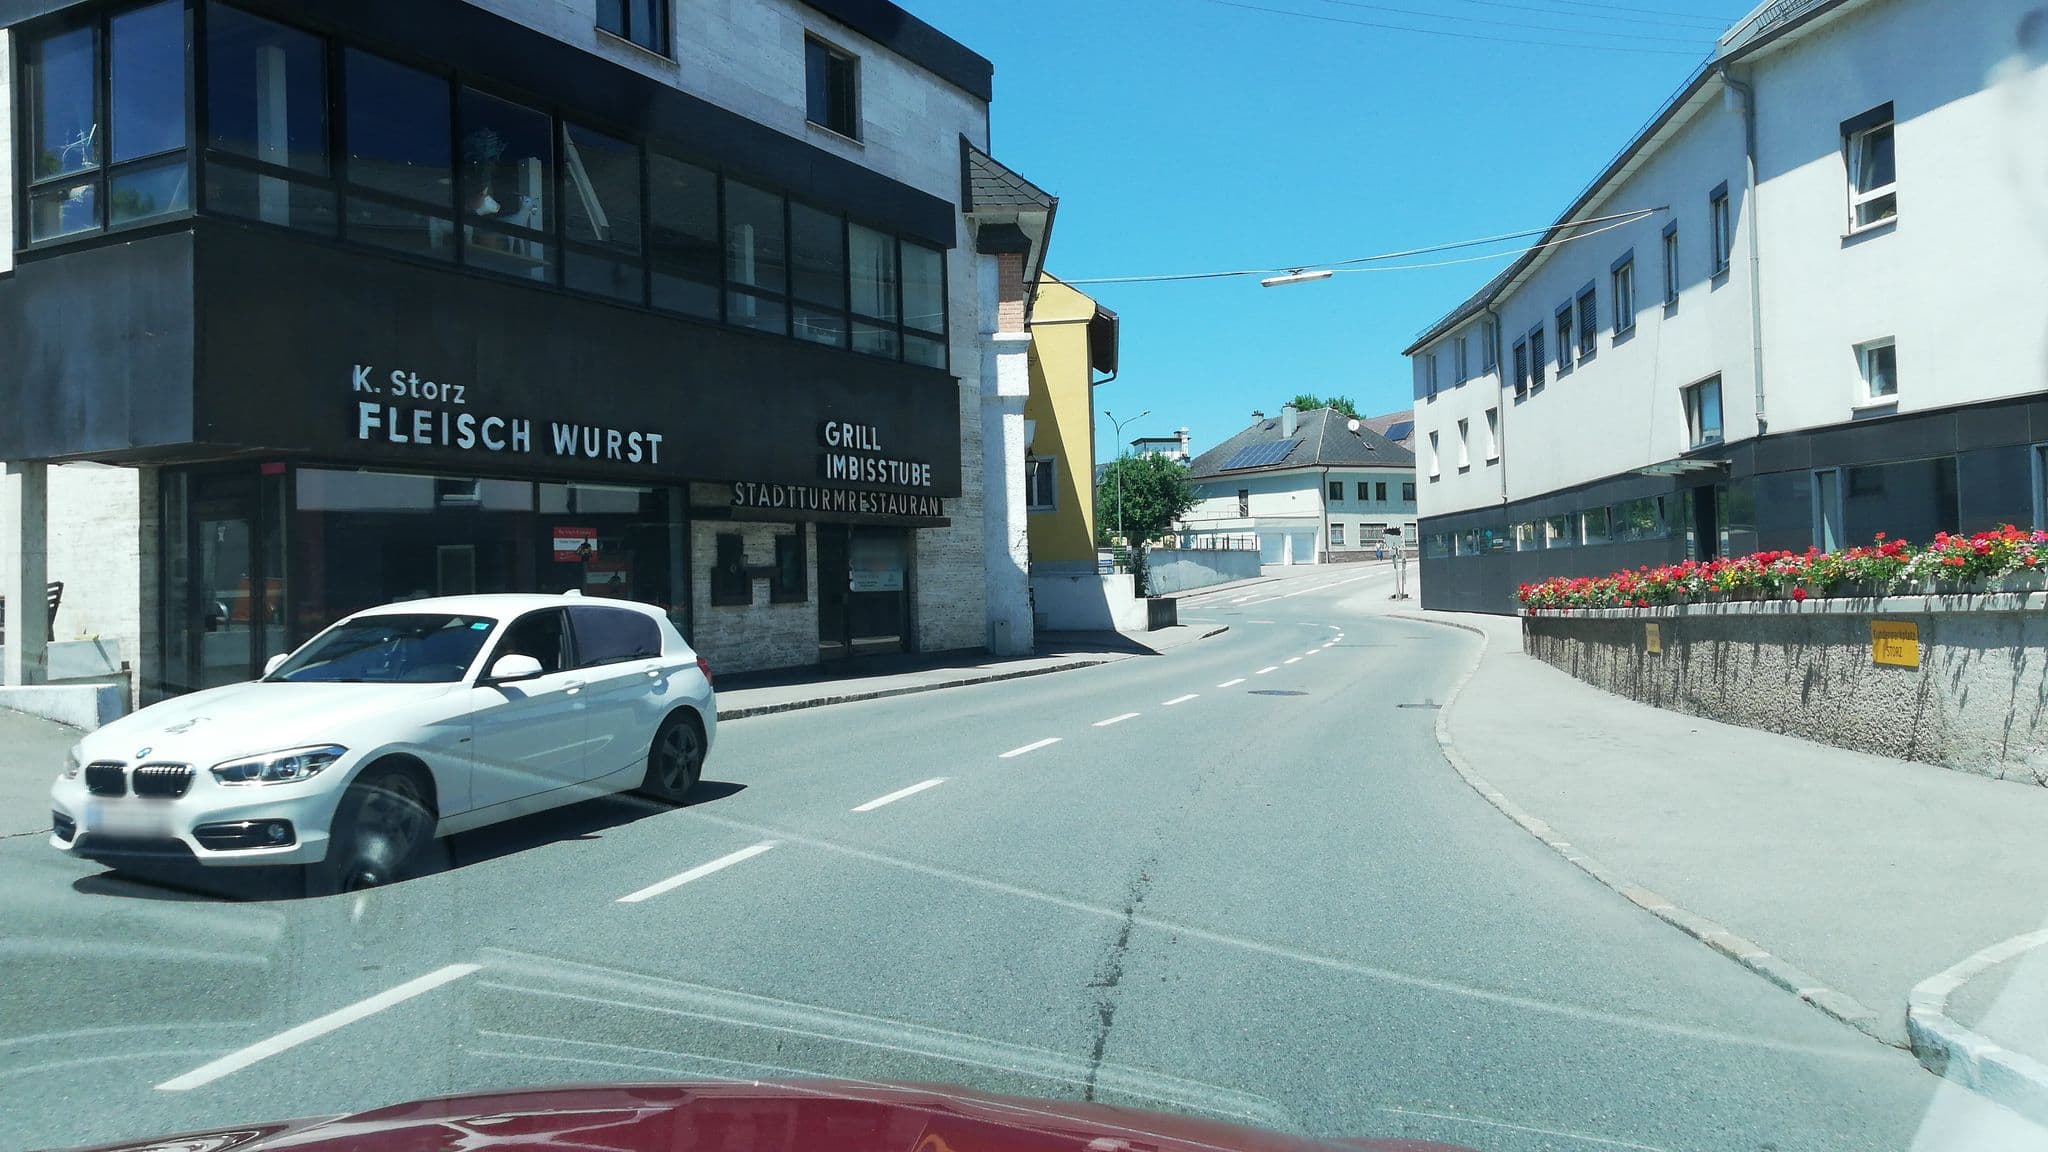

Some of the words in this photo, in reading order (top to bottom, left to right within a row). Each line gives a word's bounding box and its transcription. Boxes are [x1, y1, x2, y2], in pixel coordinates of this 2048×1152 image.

[352, 364, 381, 393] K.
[390, 369, 466, 404] Storz
[359, 401, 530, 452] FLEISCH
[552, 422, 663, 464] WURST
[825, 421, 881, 451] GRILL
[826, 453, 931, 487] IMBISSTUBE
[735, 481, 946, 517] STADTTURMRESTAURANT
